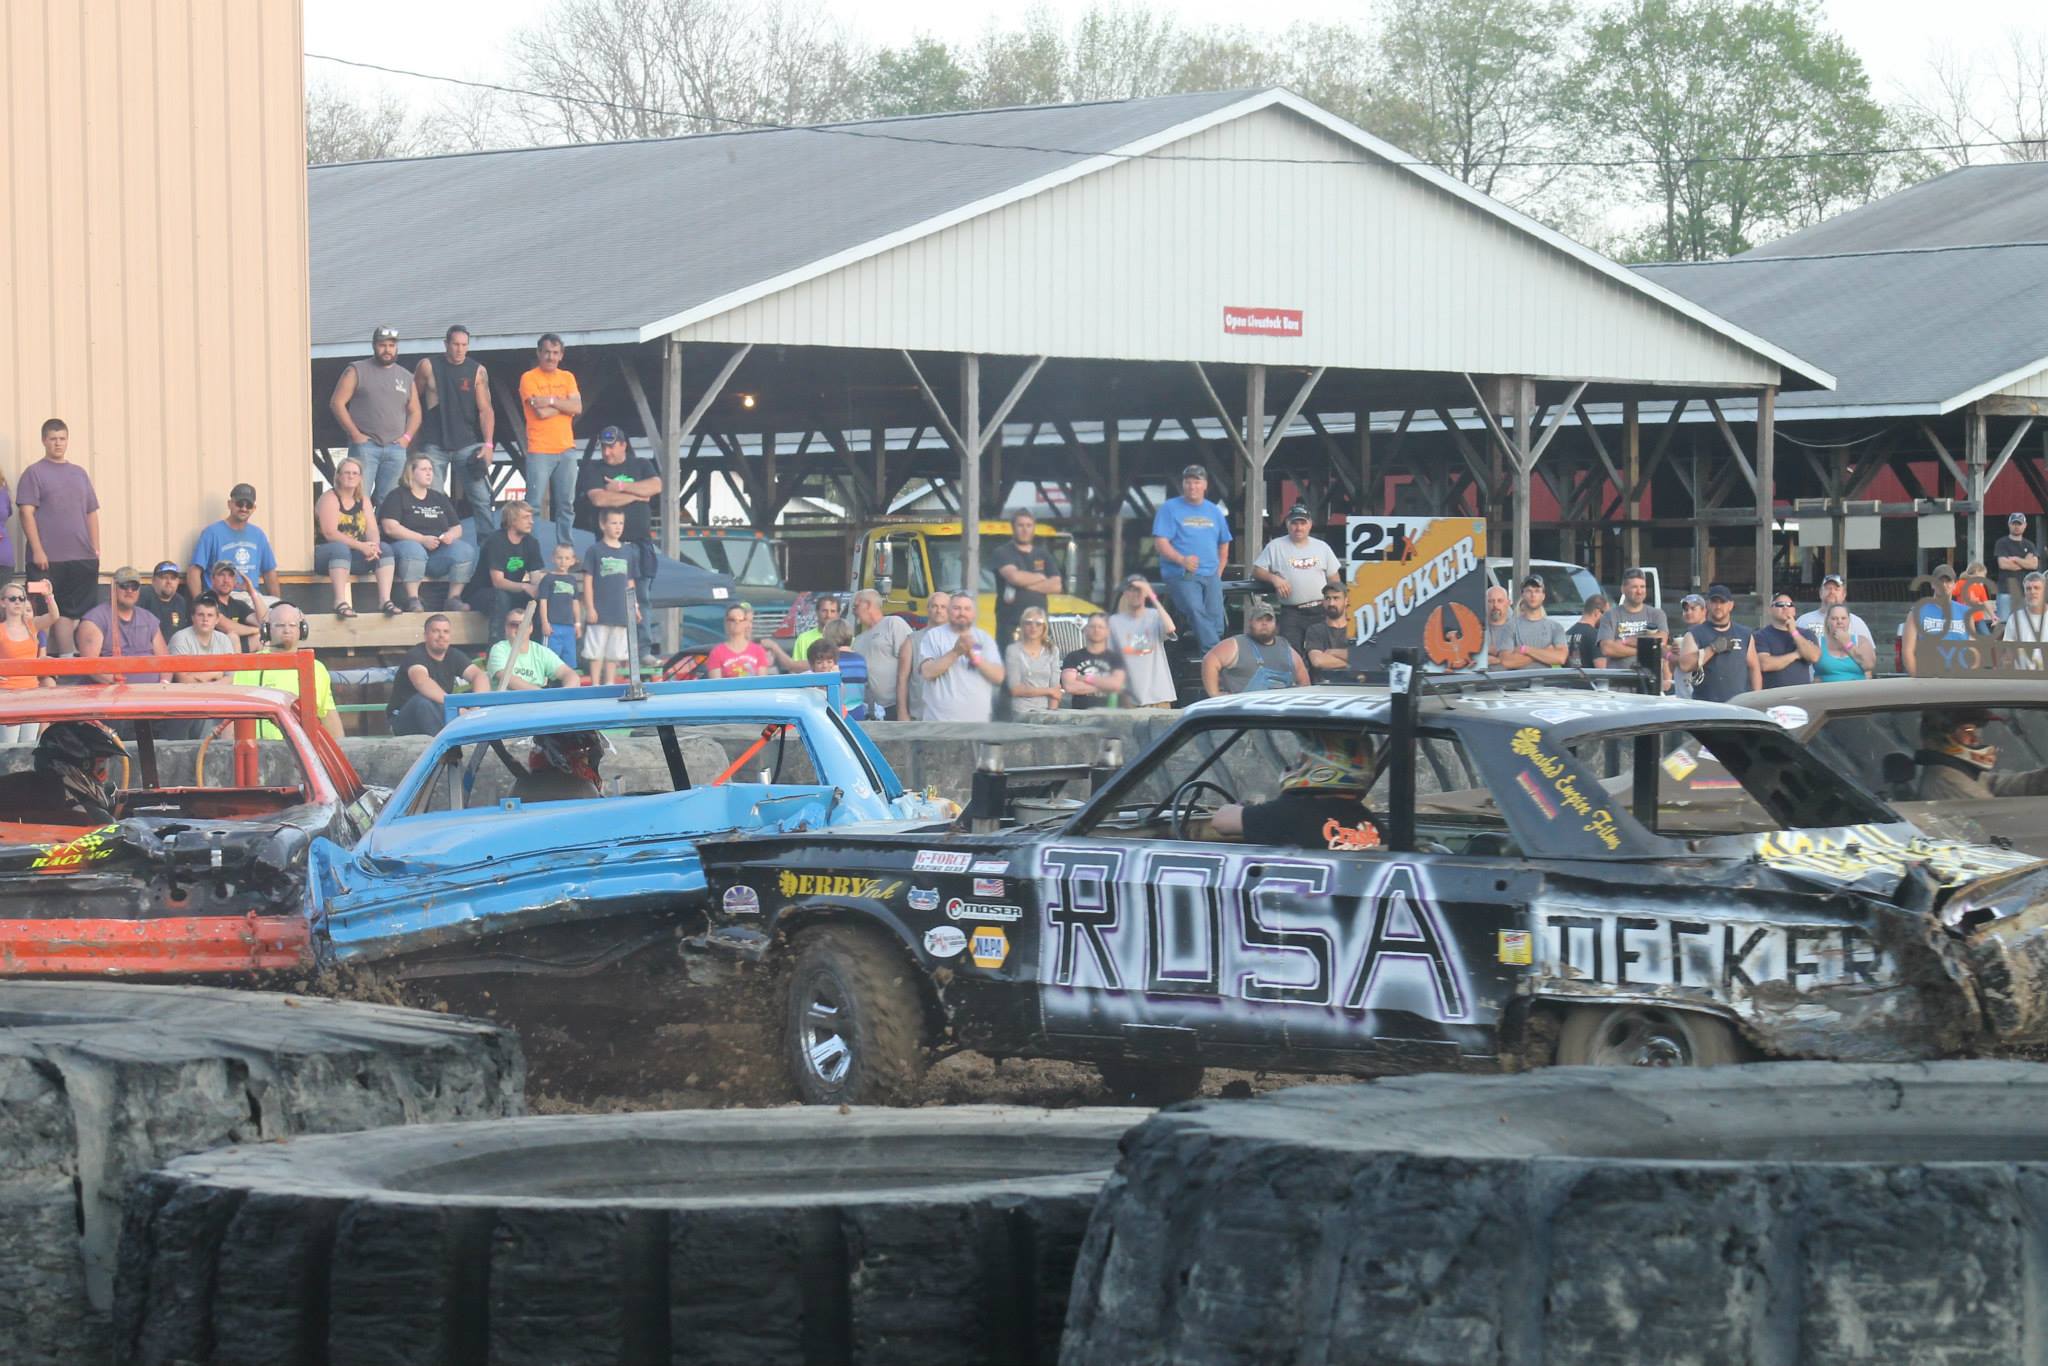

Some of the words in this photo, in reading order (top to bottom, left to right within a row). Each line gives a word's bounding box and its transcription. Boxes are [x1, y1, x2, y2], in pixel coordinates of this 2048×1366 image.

[1353, 536, 1478, 647] DECKER
[1555, 775, 1592, 816] Empire
[1583, 809, 1621, 851] Films
[916, 852, 969, 866] G-FORCE
[779, 869, 869, 898] DERBY
[963, 904, 1021, 915] MOSER
[975, 936, 1004, 958] NAPA
[1042, 847, 1467, 1018] ROSA
